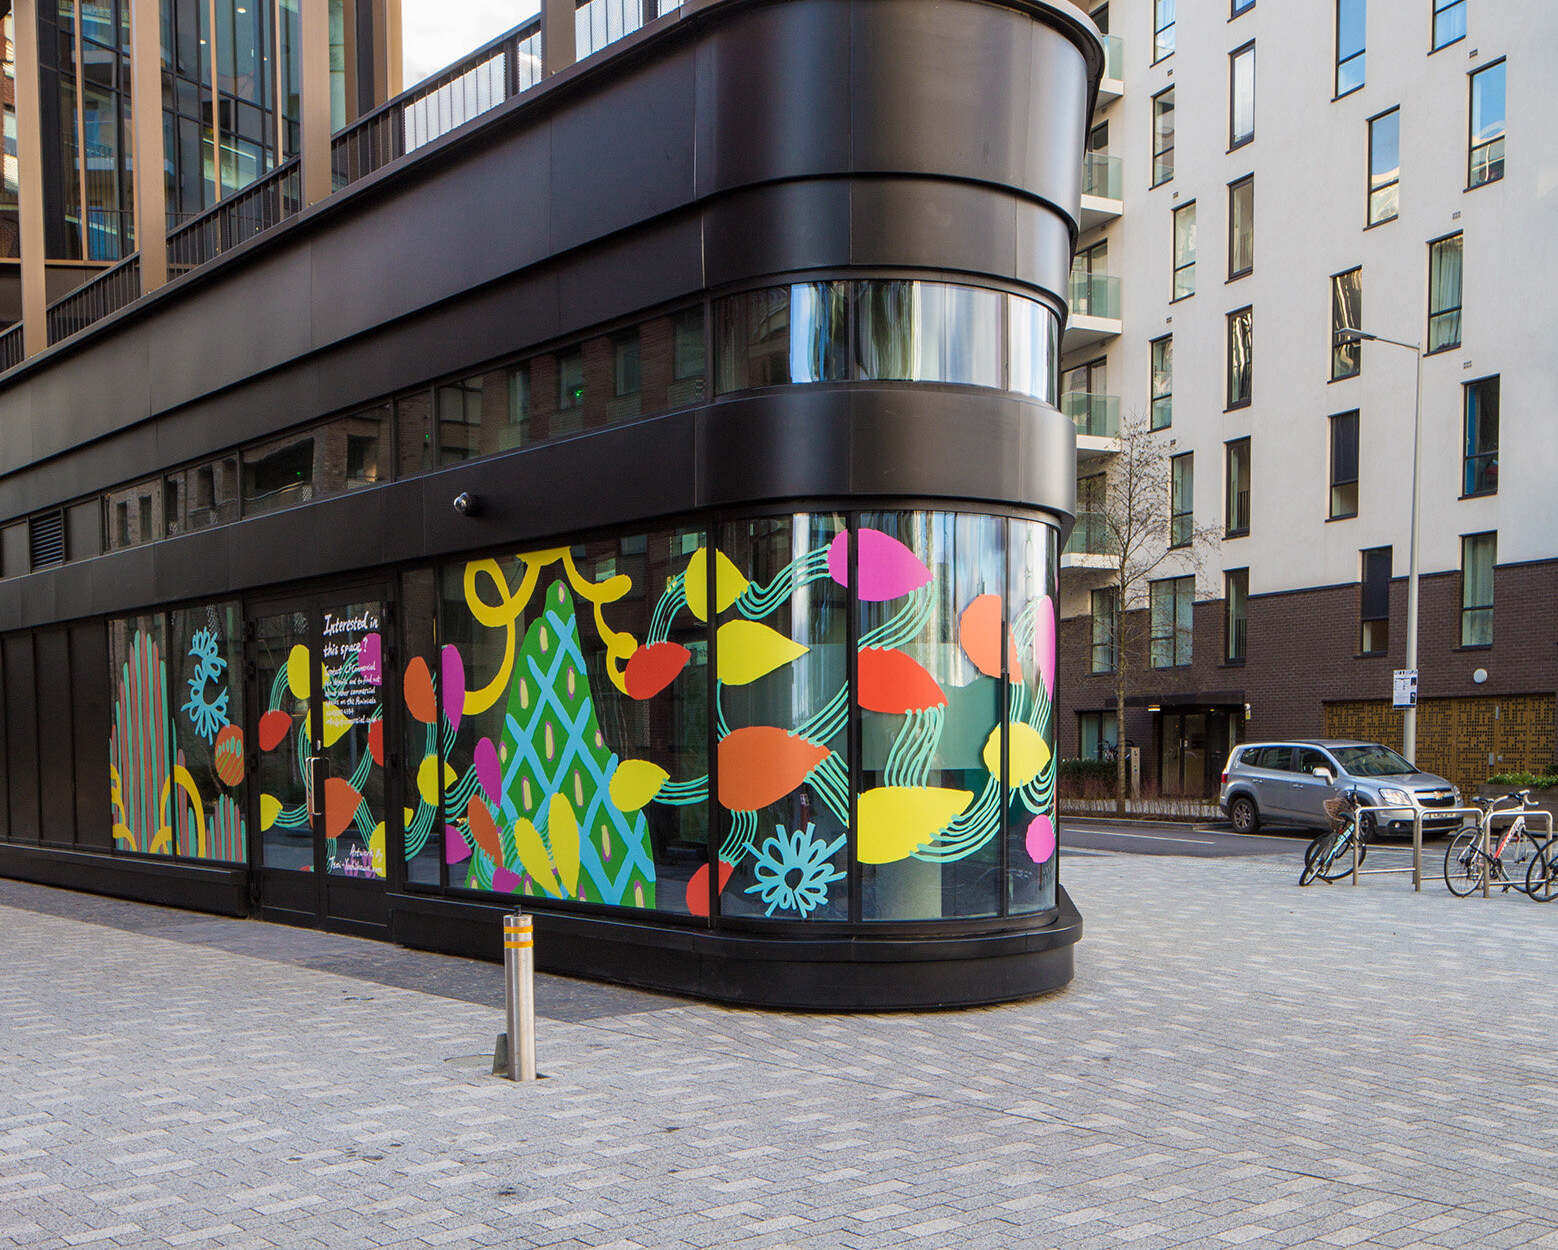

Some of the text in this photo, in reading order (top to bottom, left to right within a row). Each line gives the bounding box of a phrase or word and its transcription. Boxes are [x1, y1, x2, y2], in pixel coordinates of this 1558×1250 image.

[322, 610, 379, 636] Interested in
[323, 641, 339, 658] this
[350, 686, 376, 696] commercial
[346, 697, 355, 705] the
